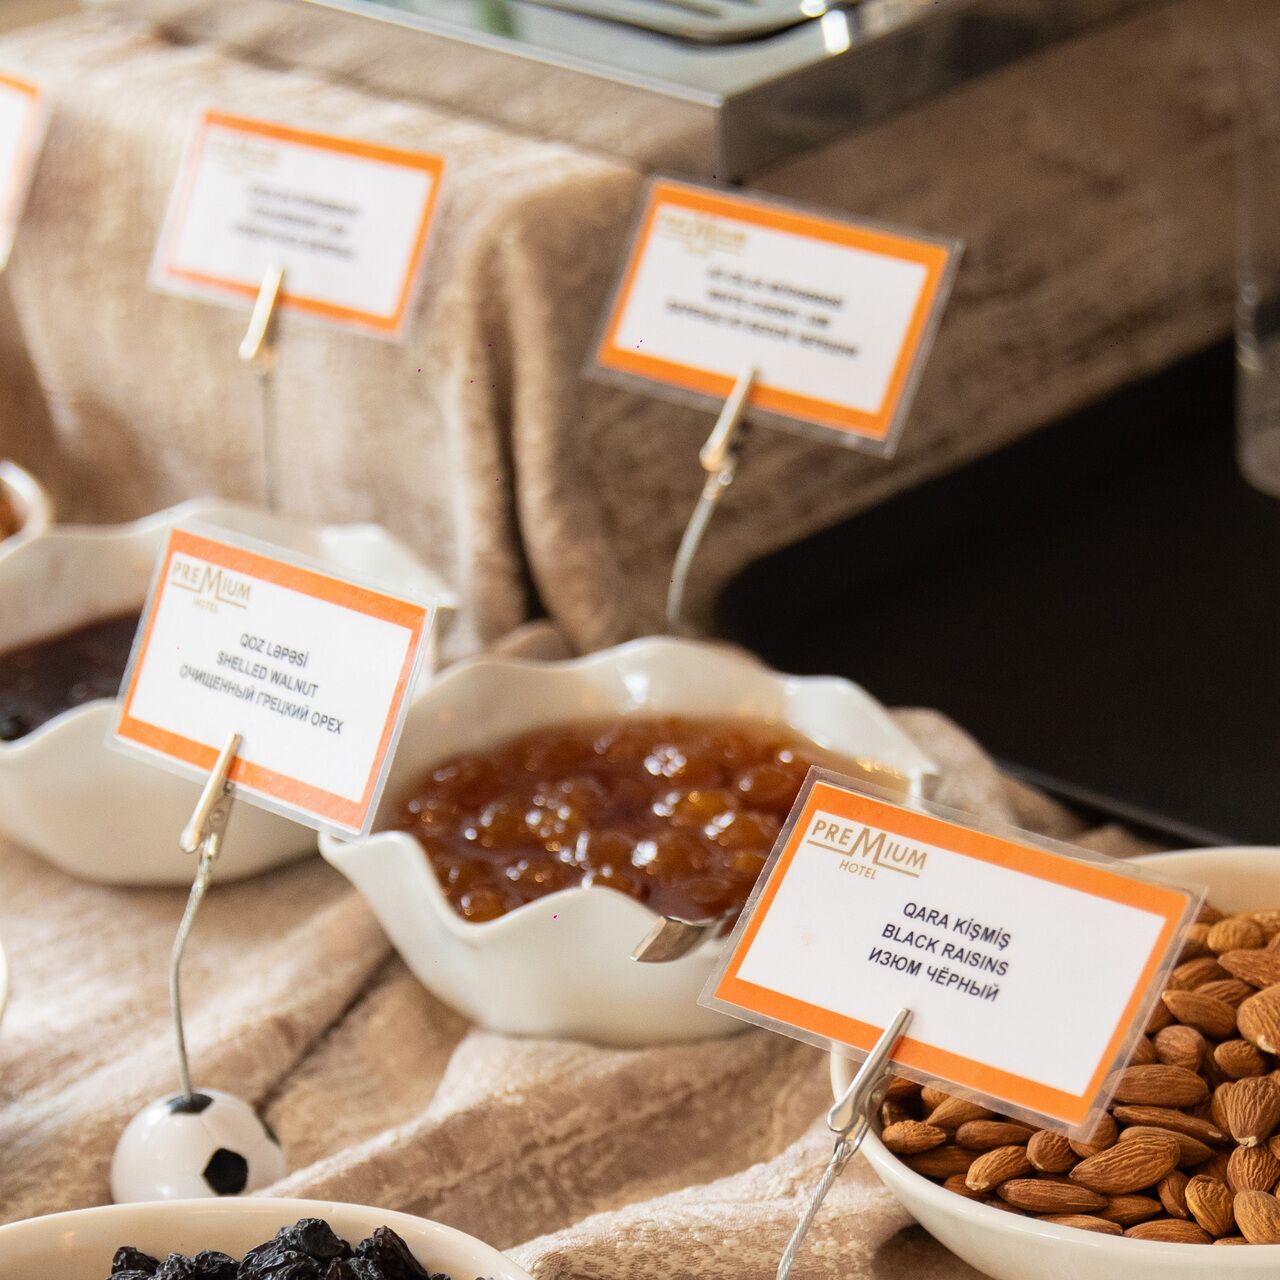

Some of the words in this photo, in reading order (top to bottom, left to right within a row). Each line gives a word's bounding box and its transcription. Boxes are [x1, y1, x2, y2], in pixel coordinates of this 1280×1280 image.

[173, 560, 252, 601] PREMIUM
[240, 632, 265, 653] QOZ
[179, 663, 255, 702] ОЧИЩЕННЫЙ
[255, 691, 310, 723] ГРЕЦКИЙ
[310, 711, 344, 735] ОРЕХ
[216, 650, 268, 680] SHELLED
[270, 669, 319, 699] WALNUT
[811, 819, 928, 871] PREMIUM
[839, 859, 878, 880] HOTEL
[881, 923, 940, 954] BLACK
[940, 942, 1010, 977] RAISINS
[903, 902, 948, 929] QARA
[952, 918, 1012, 951] KİŞMİŞ
[868, 947, 922, 977] ИЗЮМ
[925, 966, 1000, 1003] ЧЁРНЫЙ
